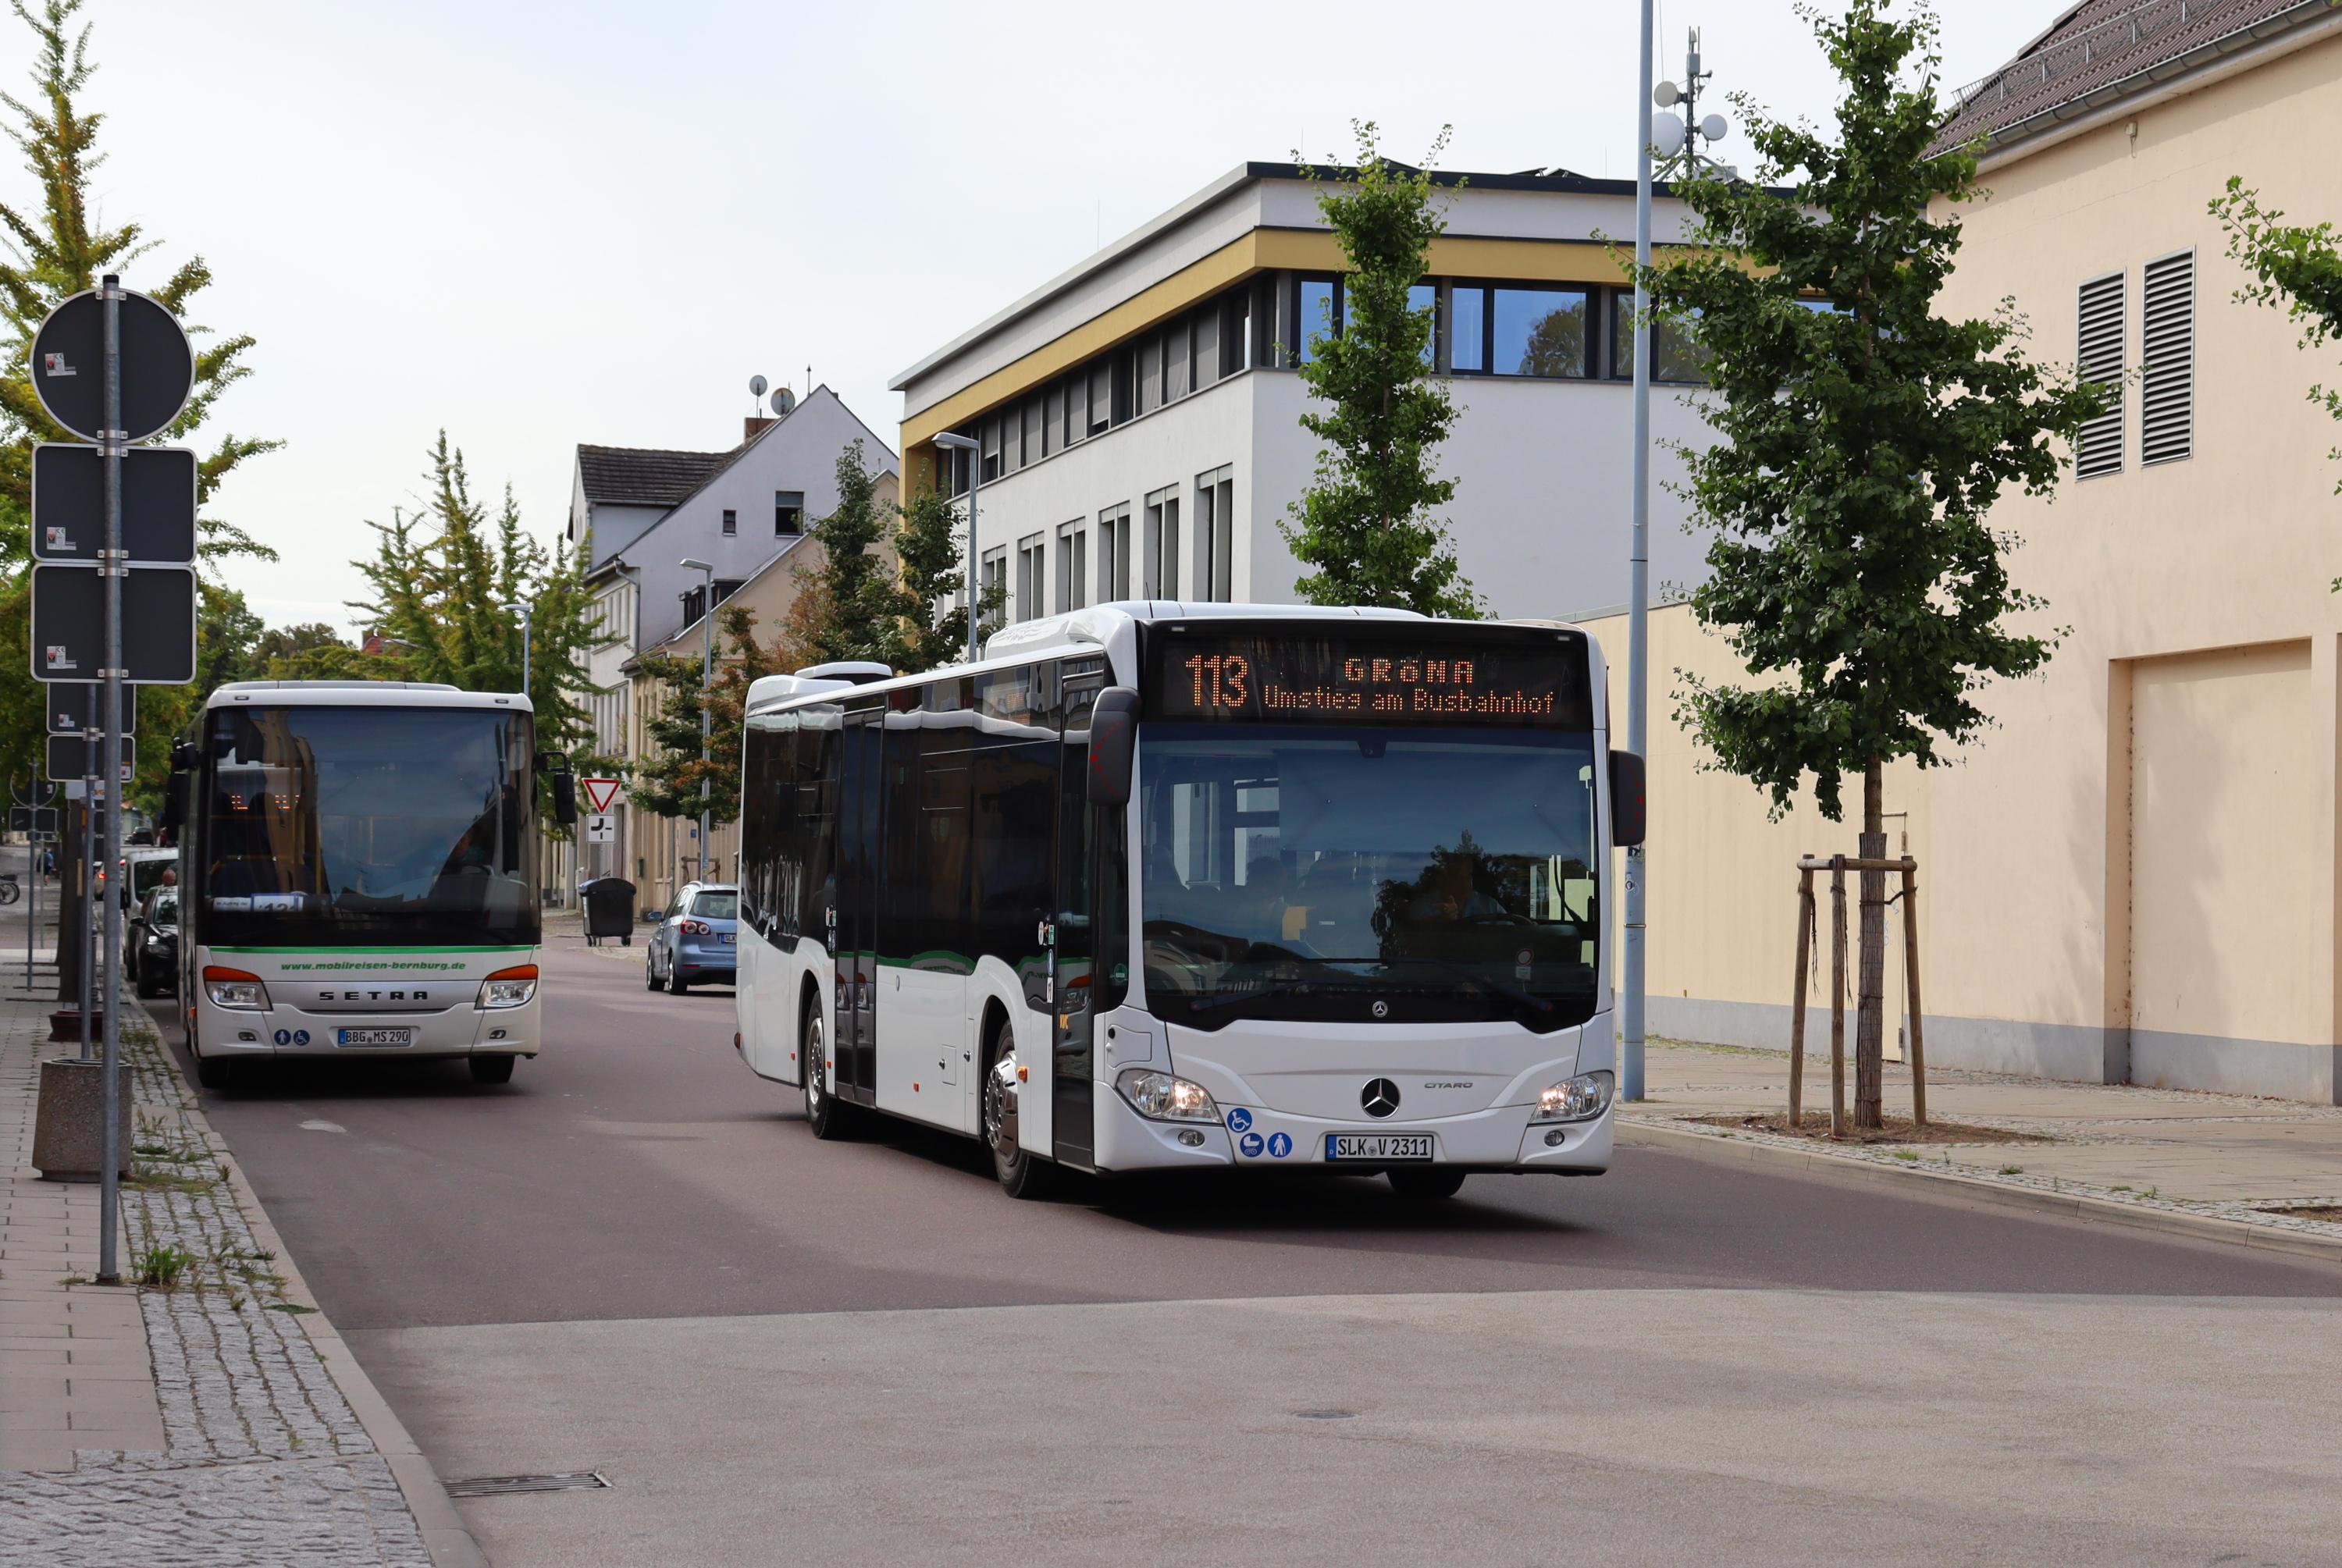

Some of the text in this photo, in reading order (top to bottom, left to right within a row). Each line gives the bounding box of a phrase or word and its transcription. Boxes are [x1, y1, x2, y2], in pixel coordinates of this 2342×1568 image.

[1185, 655, 1248, 706] 113
[1265, 684, 1554, 713] Umstieg am Busbahnhof
[281, 962, 466, 971] www.mobilreisen-bernburg.de
[319, 991, 428, 1001] SETRA
[346, 1031, 408, 1043] BBG MS 290
[1337, 1139, 1367, 1155] SLK
[1378, 1139, 1386, 1155] V
[1390, 1139, 1428, 1156] 2311
